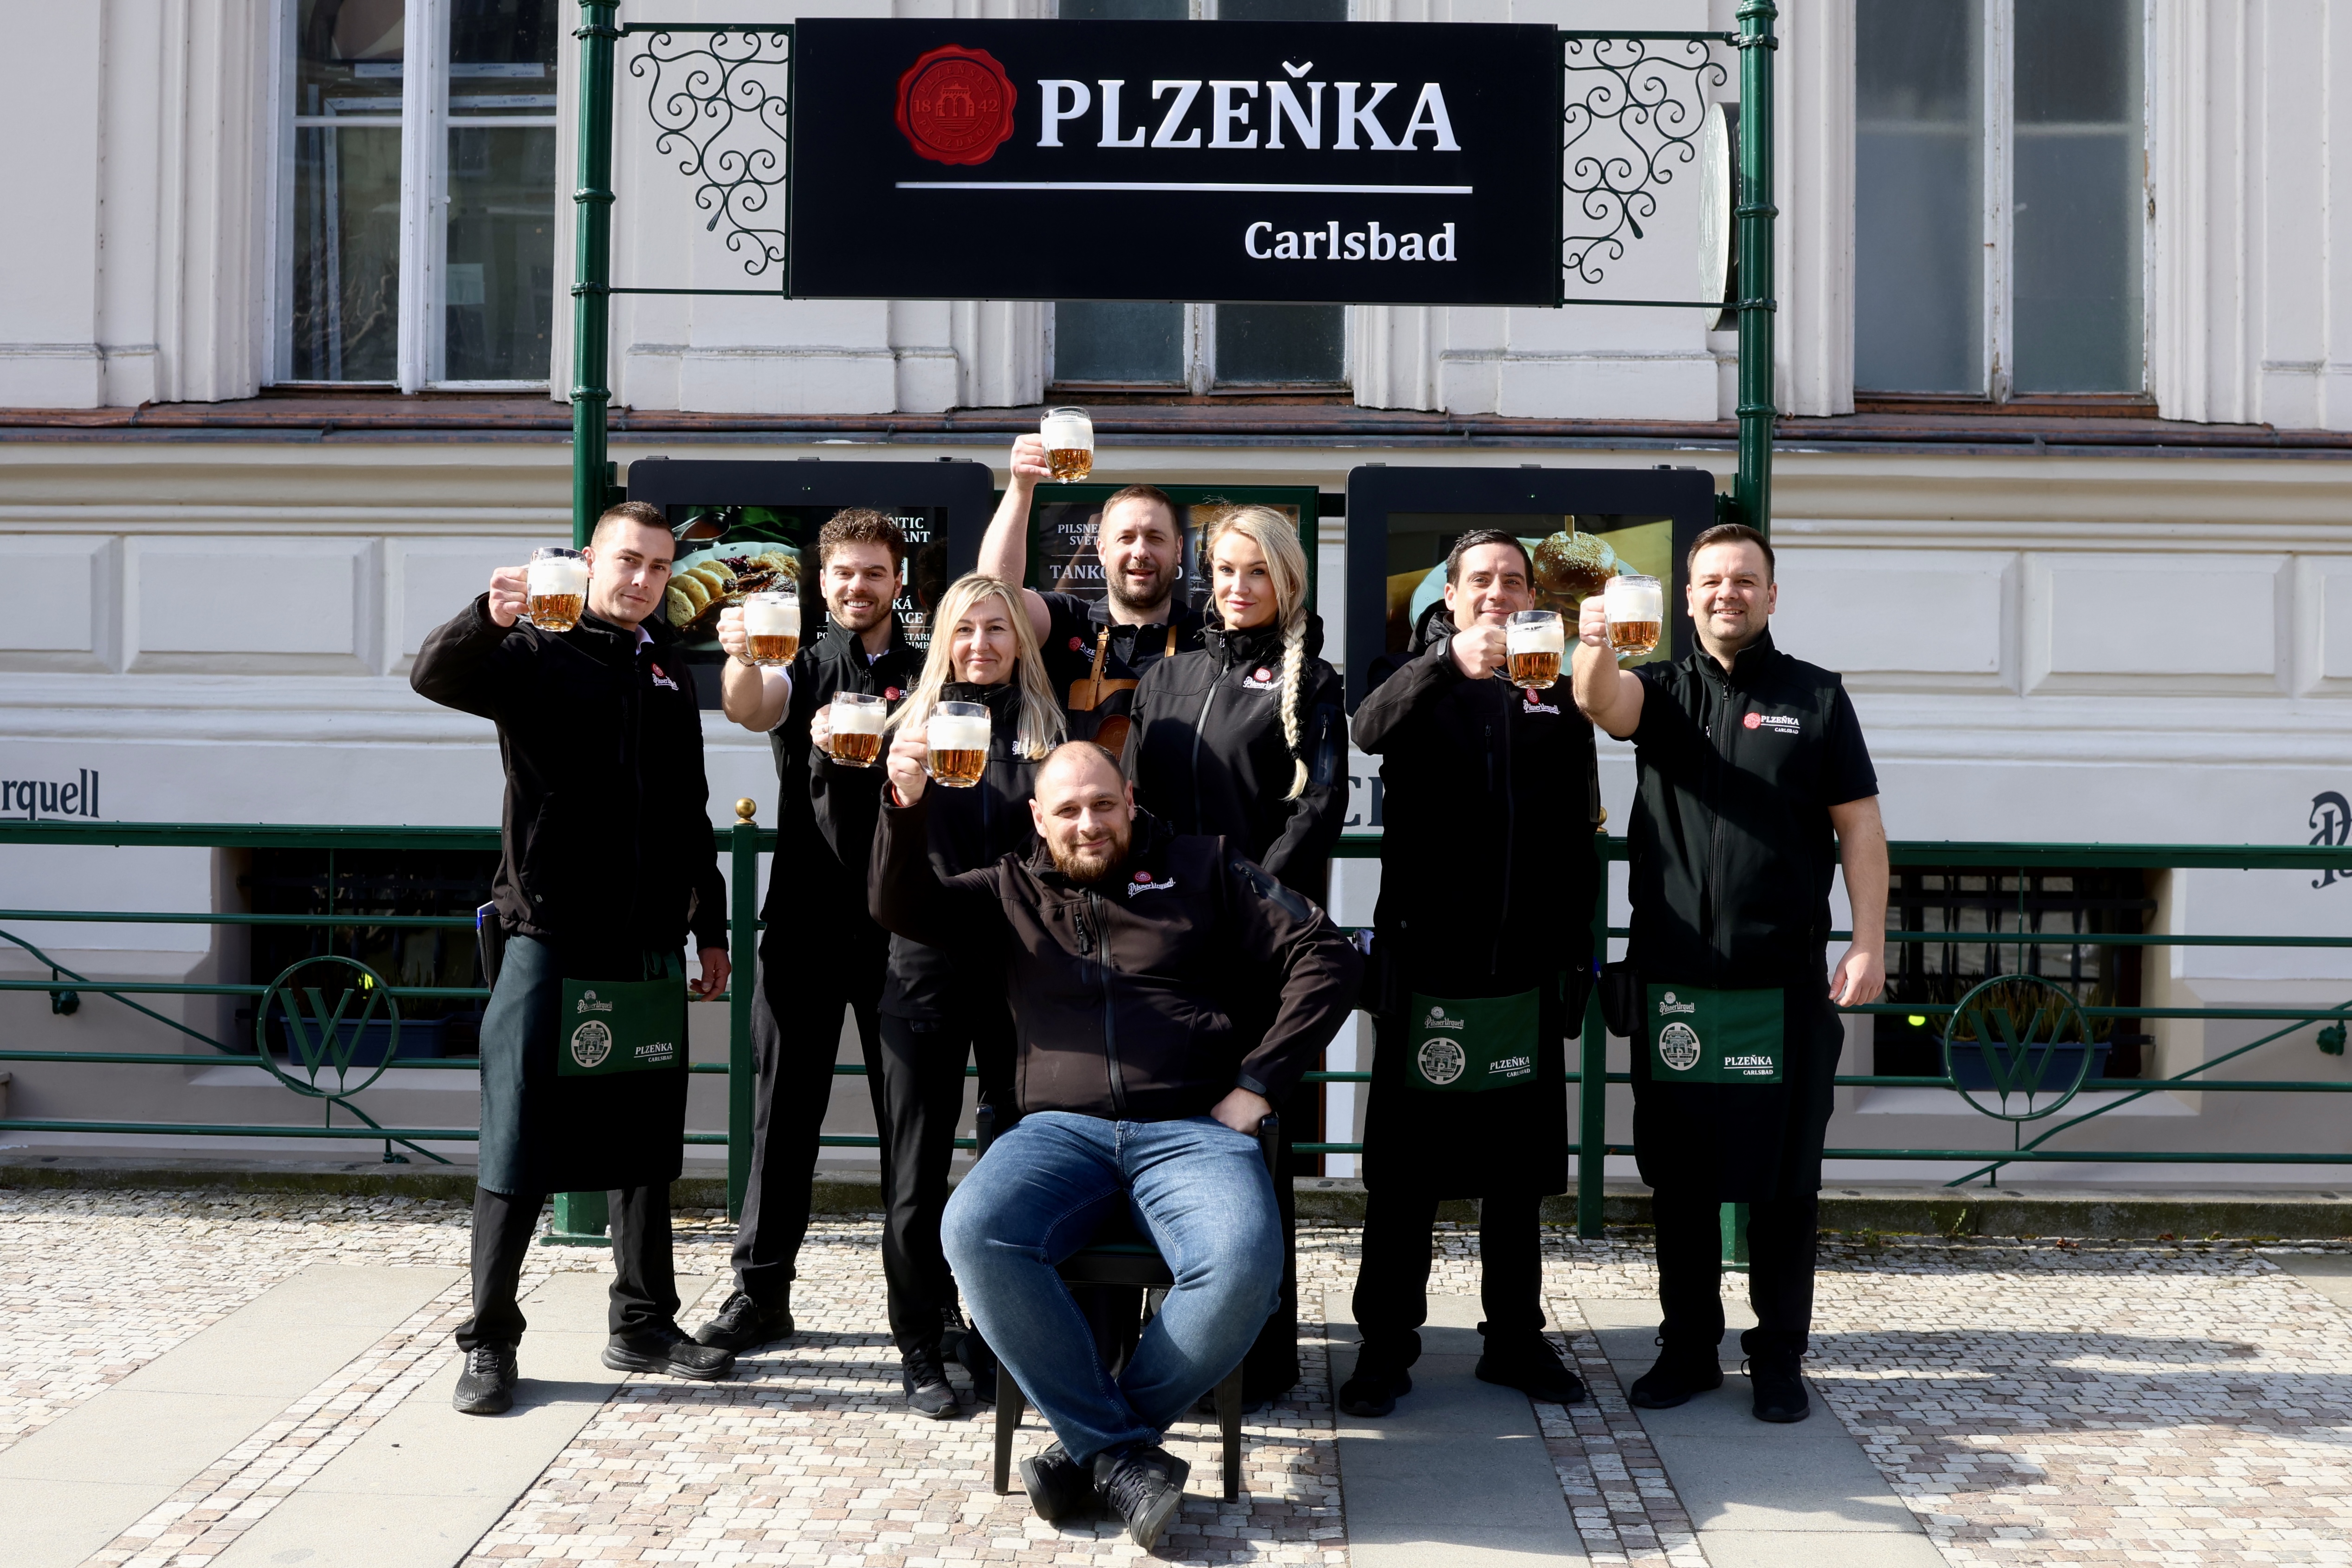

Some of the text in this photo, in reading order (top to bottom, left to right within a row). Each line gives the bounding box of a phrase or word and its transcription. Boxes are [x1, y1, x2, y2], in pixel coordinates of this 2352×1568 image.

[914, 99, 999, 112] 18 42
[1037, 60, 1461, 151] PLZEŇKA
[1244, 221, 1458, 261] Carlsbad
[1058, 524, 1100, 533] PILSNE
[1761, 715, 1800, 726] PLZEŇKA
[1, 768, 100, 821] rquell
[1128, 877, 1174, 898] Pilsner Urquell
[577, 999, 612, 1013] Pilsner Urquell
[1659, 1001, 1694, 1016] Pilsner Urquell
[1425, 1015, 1464, 1029] Pilsner Urquell
[635, 1042, 673, 1055] PLZEŇKA
[1490, 1056, 1530, 1070] PLZEŇKA
[1724, 1055, 1773, 1066] PLZEŇKA
[1507, 1069, 1530, 1077] CARLSBAD
